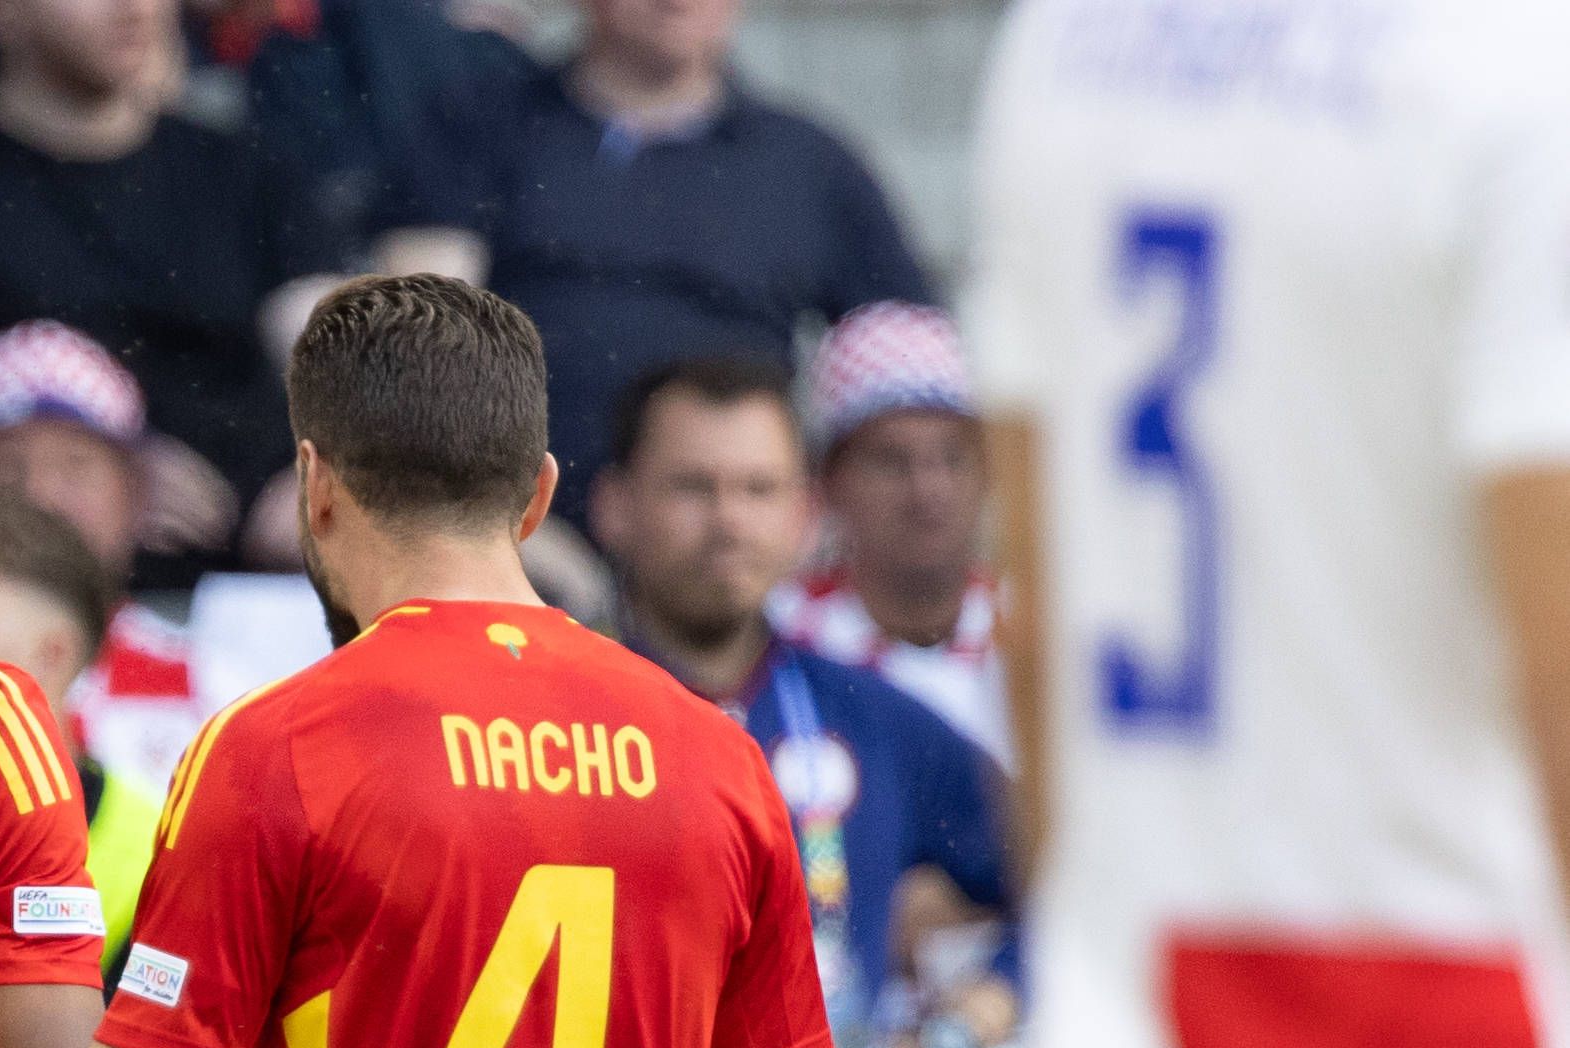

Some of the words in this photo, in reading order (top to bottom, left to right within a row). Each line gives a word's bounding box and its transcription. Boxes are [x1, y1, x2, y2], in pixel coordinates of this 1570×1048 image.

[1102, 206, 1222, 734] 3
[440, 714, 657, 799] NACHO
[18, 889, 48, 901] UEFA
